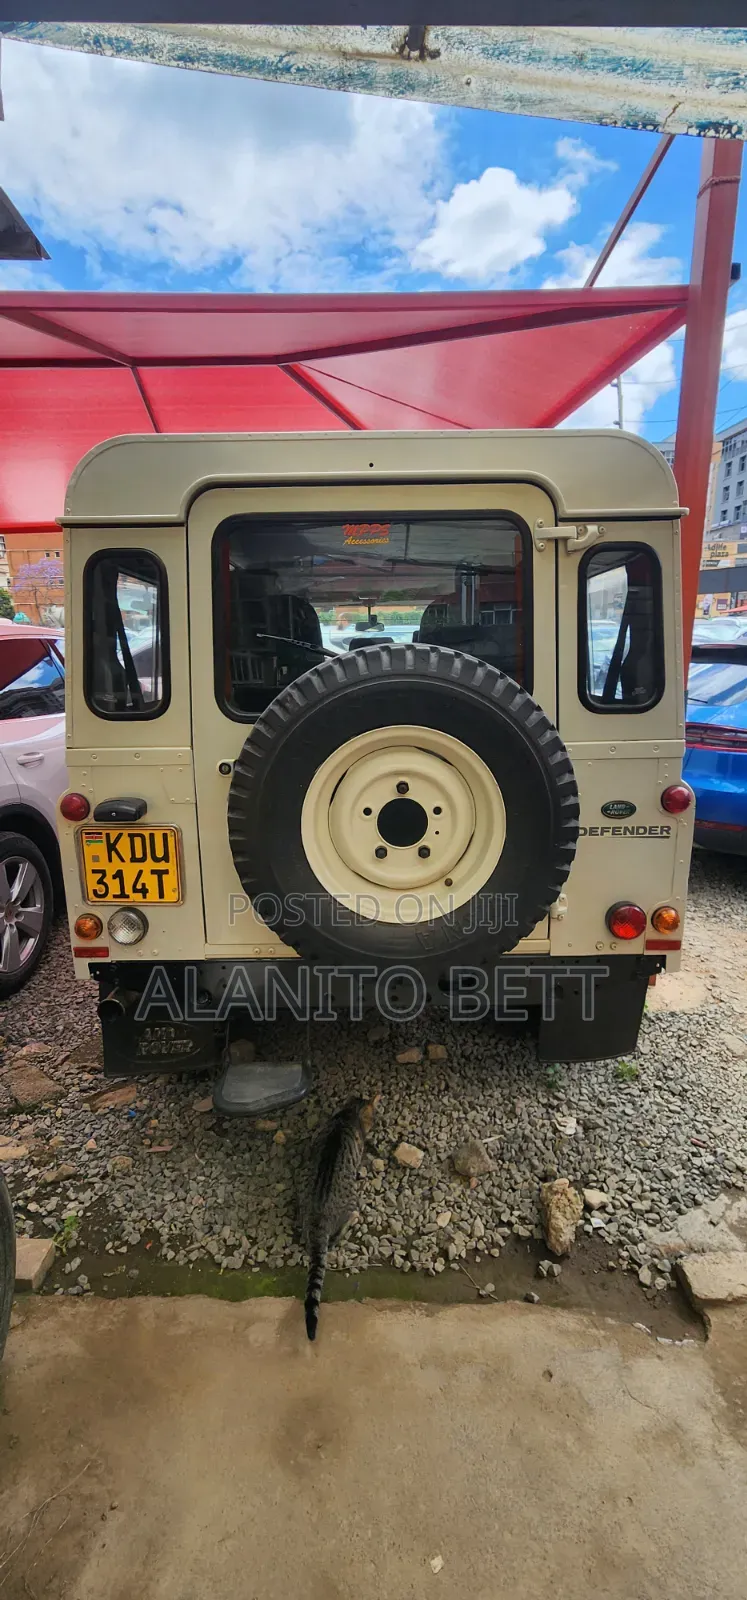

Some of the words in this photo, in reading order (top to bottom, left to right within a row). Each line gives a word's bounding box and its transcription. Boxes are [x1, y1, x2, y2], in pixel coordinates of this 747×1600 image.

[342, 536, 390, 545] Accessories
[578, 826, 671, 836] DEFENDER
[105, 832, 170, 863] KDU
[91, 869, 169, 899] 314T
